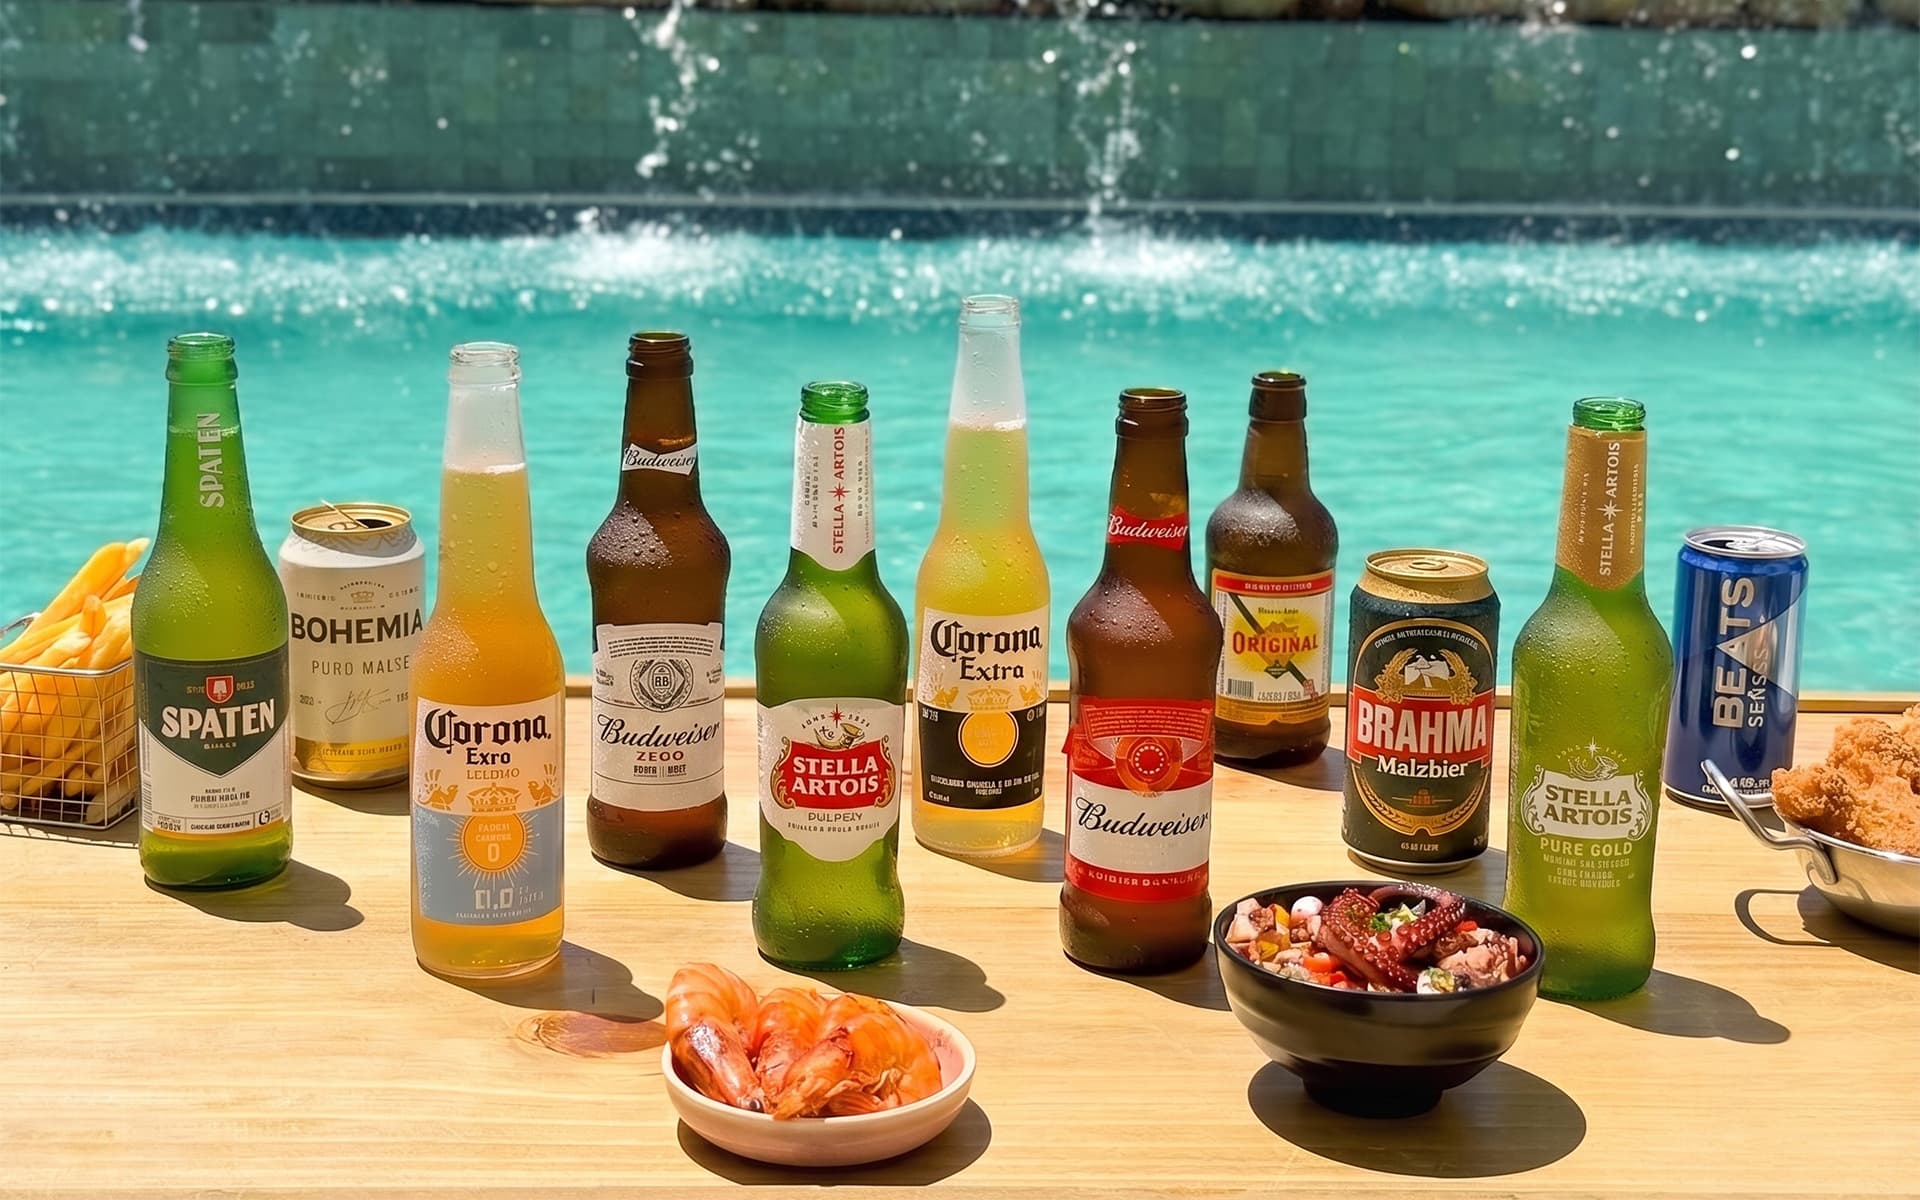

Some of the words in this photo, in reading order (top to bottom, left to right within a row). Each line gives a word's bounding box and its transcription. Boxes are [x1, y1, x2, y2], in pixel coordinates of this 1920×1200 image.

[197, 413, 225, 508] SPATEN
[834, 426, 845, 480] ARTOIS
[1605, 442, 1621, 498] ARTOIS
[833, 503, 845, 554] STELLA
[1599, 522, 1615, 576] STELLA
[291, 608, 423, 644] BOHEMIA
[959, 656, 1025, 681] Extra
[1712, 576, 1755, 729] BEATS
[161, 698, 275, 740] SPATEN
[597, 713, 720, 747] Budweiser
[1357, 698, 1487, 754] BRAHMA
[793, 756, 879, 776] STELLA
[1376, 755, 1469, 778] Malzbier
[792, 775, 879, 796] ARTOIS
[1545, 784, 1632, 807] STELLA
[1075, 796, 1209, 837] Budweiser
[1543, 804, 1632, 826] ARTOIS
[1540, 837, 1583, 856] PURE
[1590, 842, 1633, 857] GOLD
